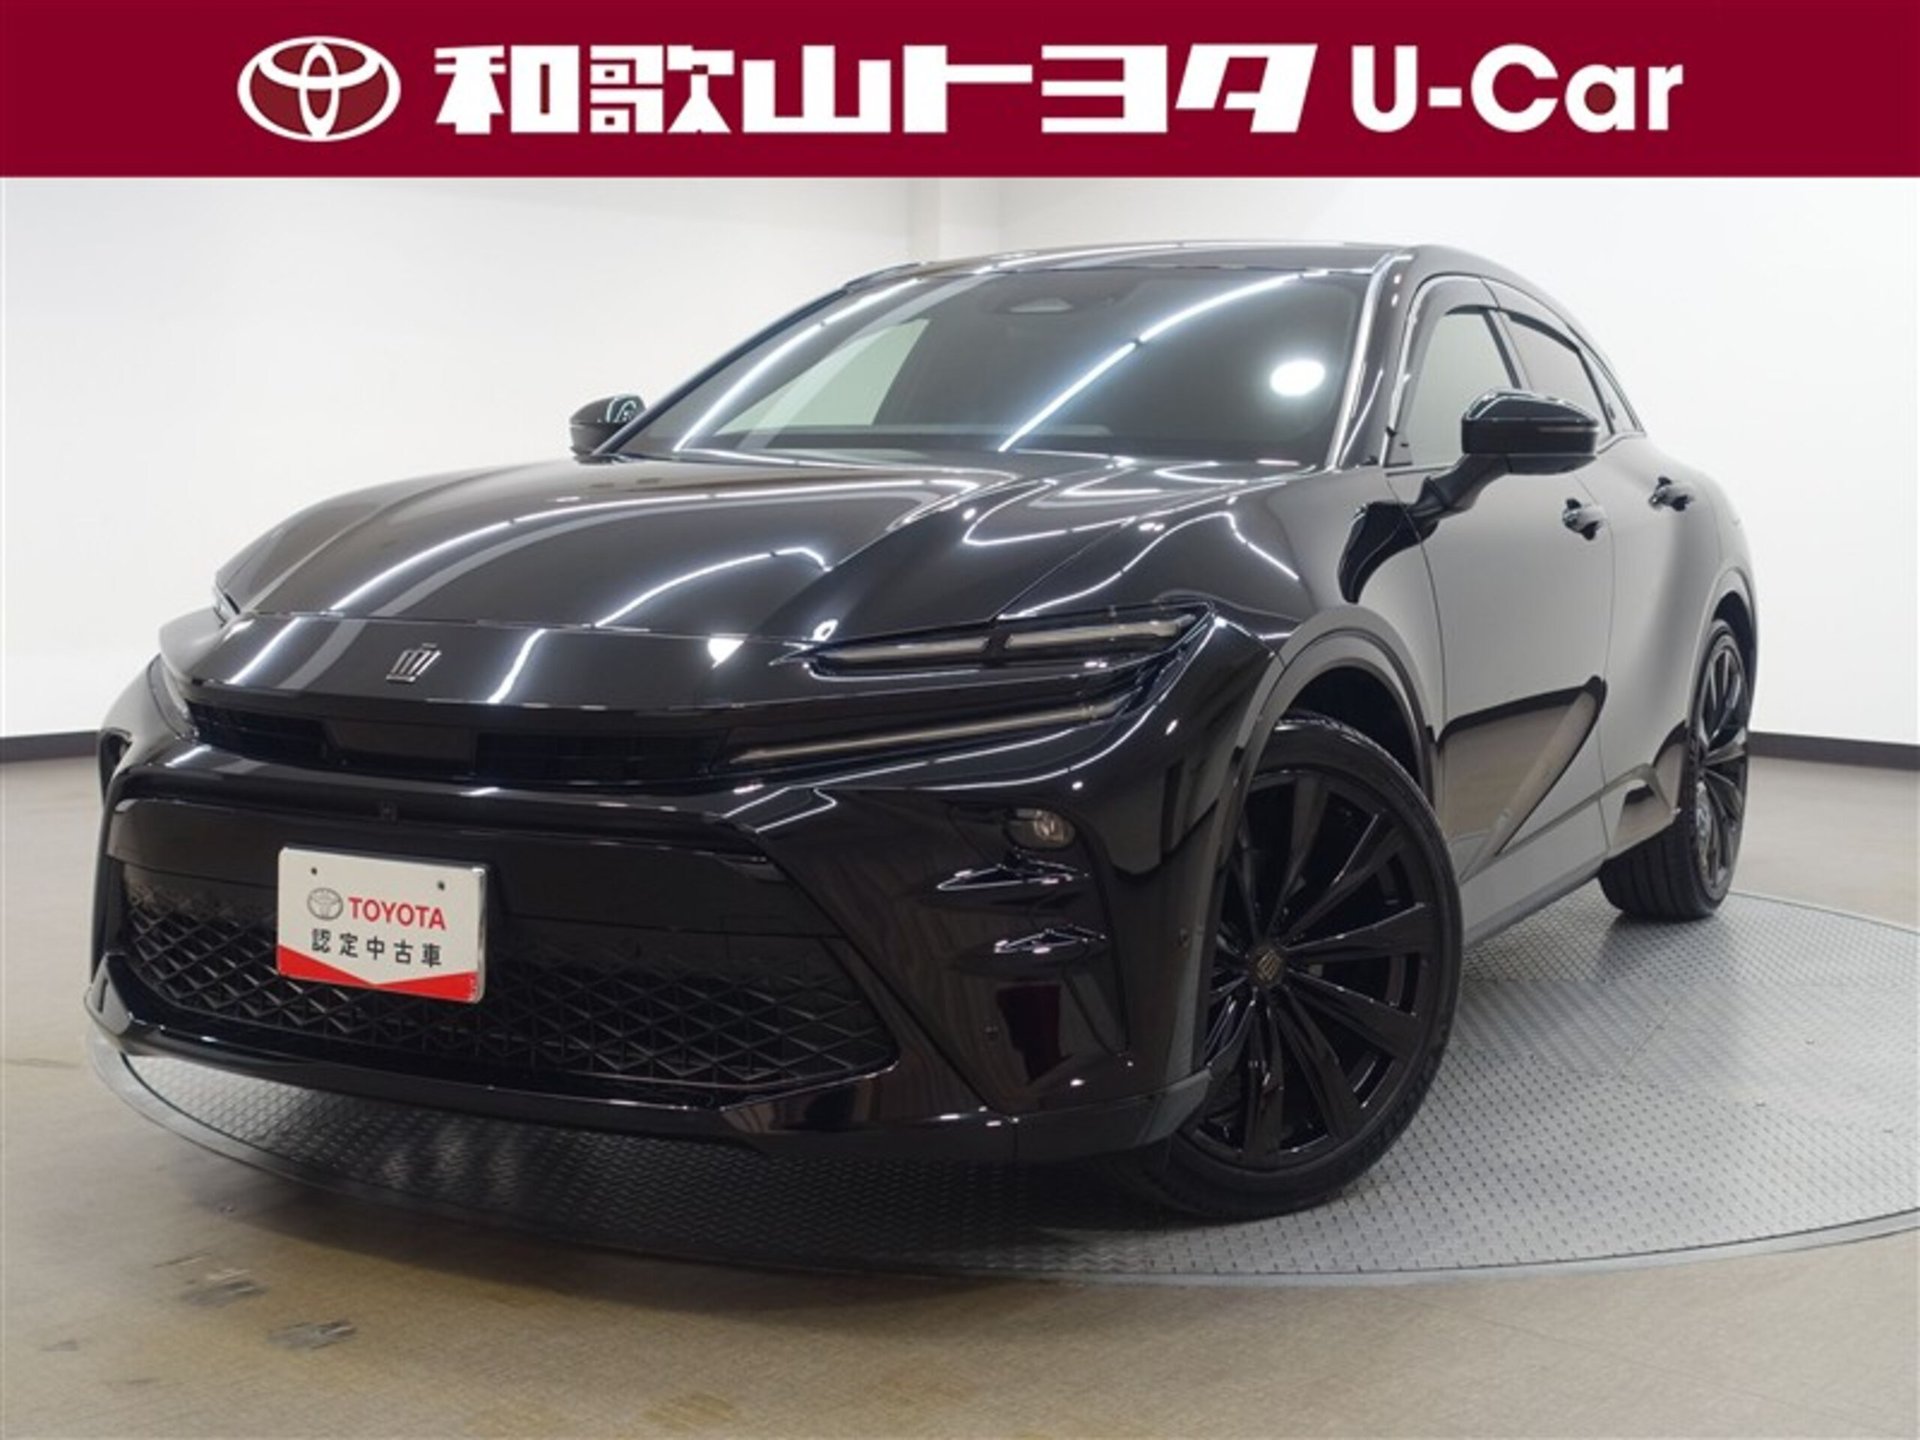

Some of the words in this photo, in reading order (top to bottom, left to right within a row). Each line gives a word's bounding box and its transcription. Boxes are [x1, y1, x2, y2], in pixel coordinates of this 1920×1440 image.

[348, 897, 446, 930] TOYOTA
[311, 928, 442, 967] 認定中古車
